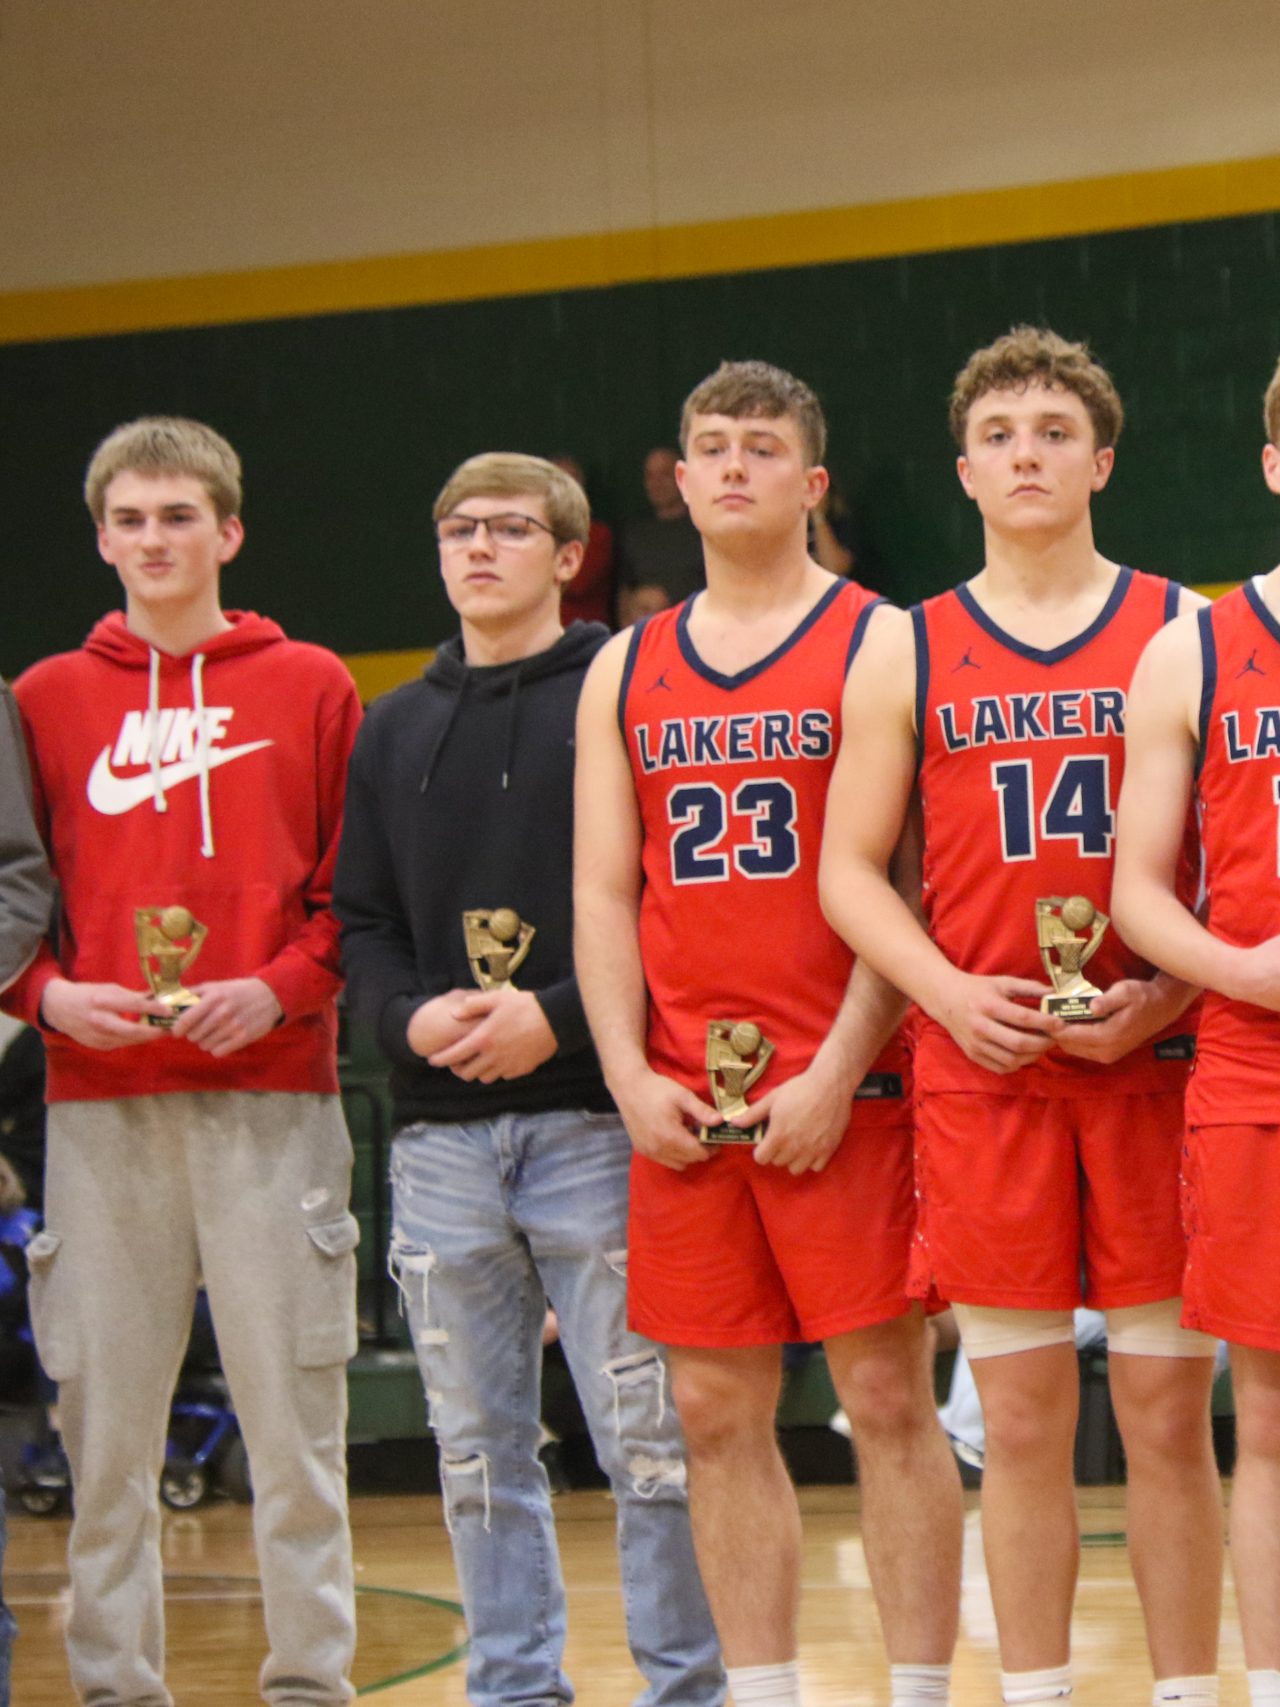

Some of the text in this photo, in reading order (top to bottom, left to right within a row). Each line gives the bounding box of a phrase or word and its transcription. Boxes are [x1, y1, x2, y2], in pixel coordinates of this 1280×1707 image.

[111, 706, 235, 767] NIKE
[635, 709, 832, 774] LAKERS
[936, 688, 1127, 754] LAKER
[667, 778, 800, 886] 23
[991, 755, 1115, 862] 14
